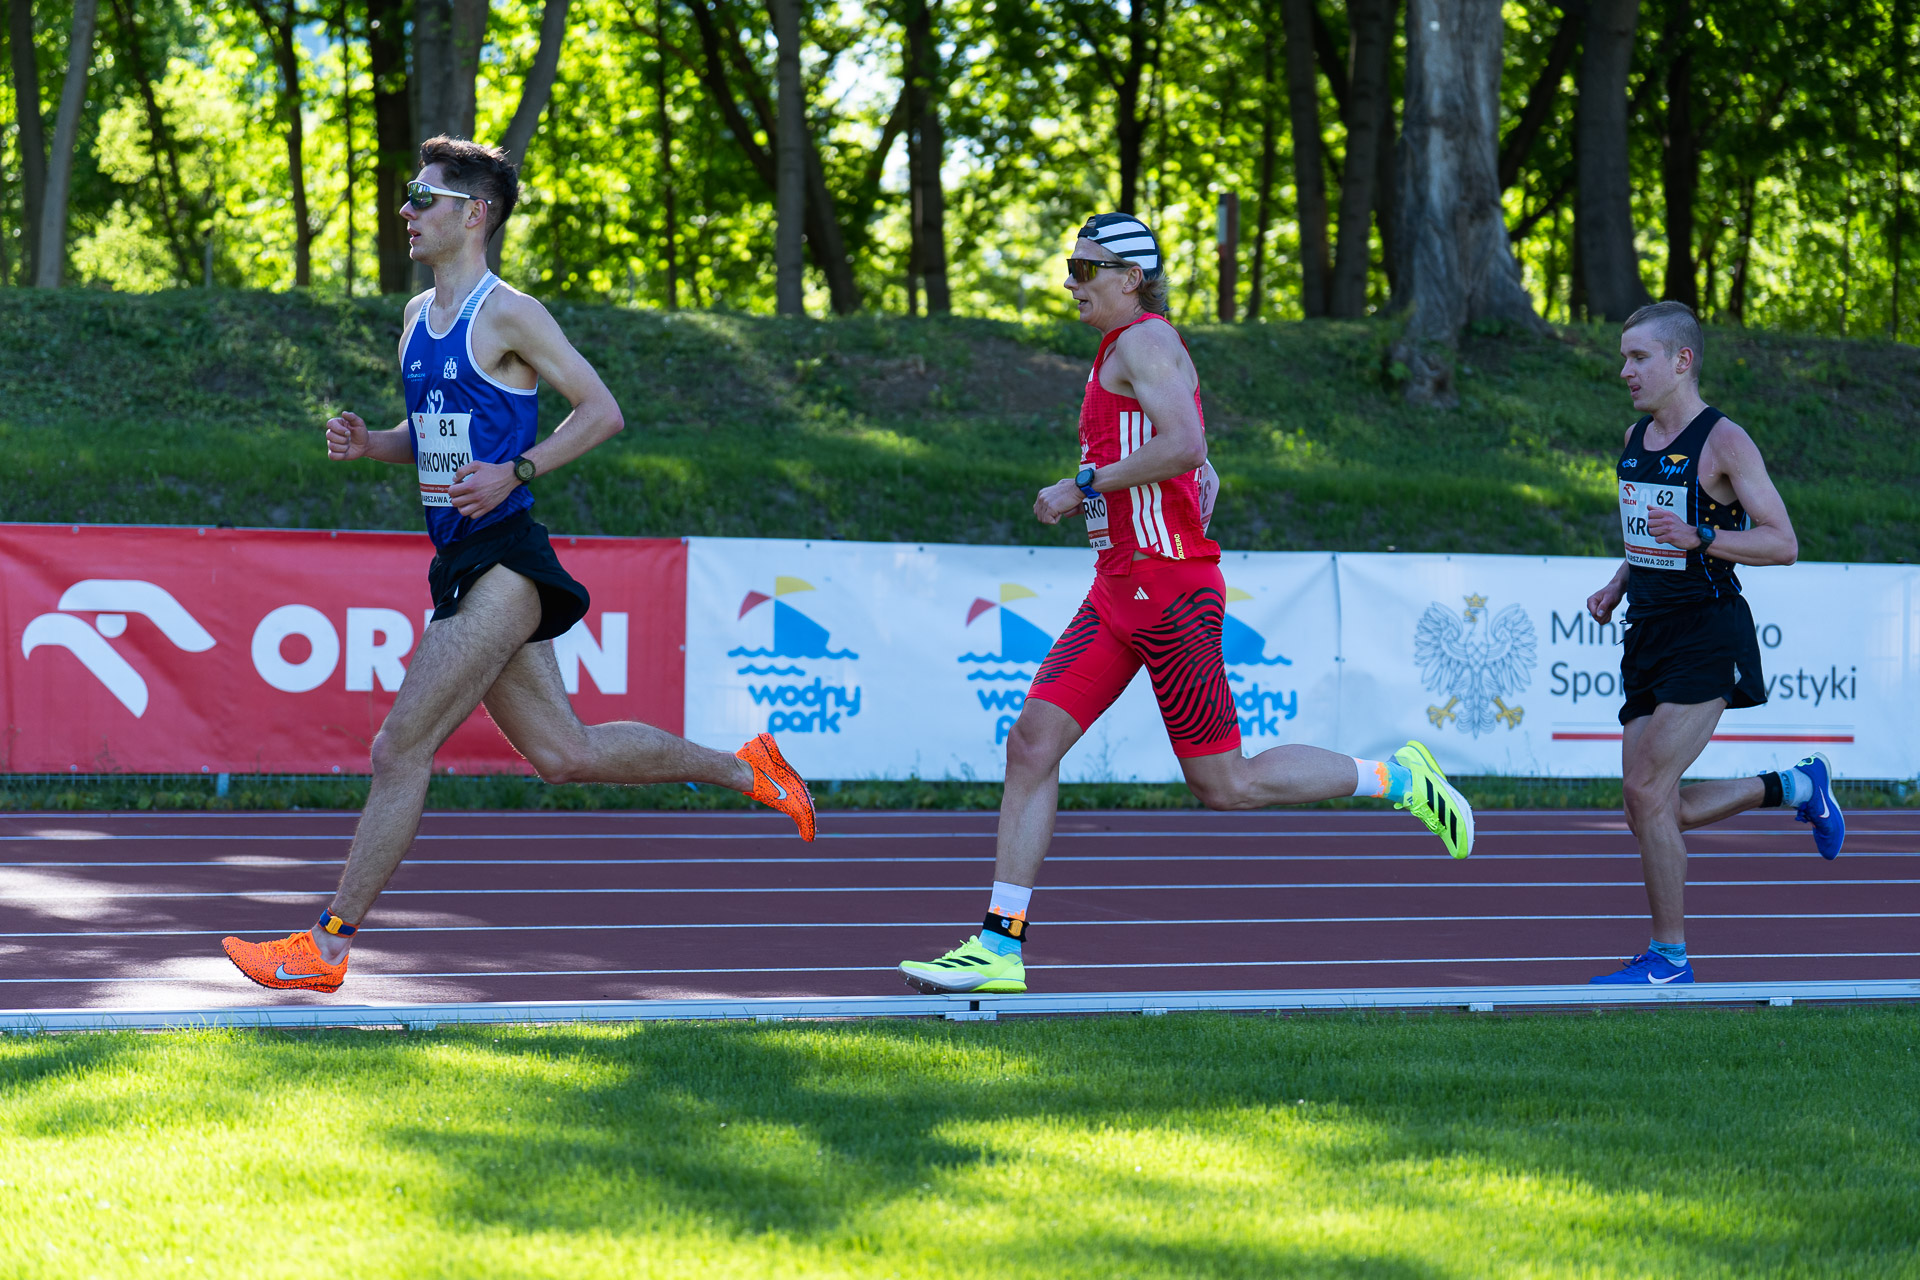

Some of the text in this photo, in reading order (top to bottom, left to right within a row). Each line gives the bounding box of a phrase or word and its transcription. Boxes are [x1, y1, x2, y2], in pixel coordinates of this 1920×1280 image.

[439, 419, 457, 437] 81
[1658, 455, 1690, 480] Sopot
[1656, 490, 1674, 507] 62
[1627, 516, 1656, 537] KR
[1656, 559, 1675, 567] 2025
[251, 603, 628, 695] ORN
[748, 676, 861, 719] wodny
[768, 704, 841, 734] park
